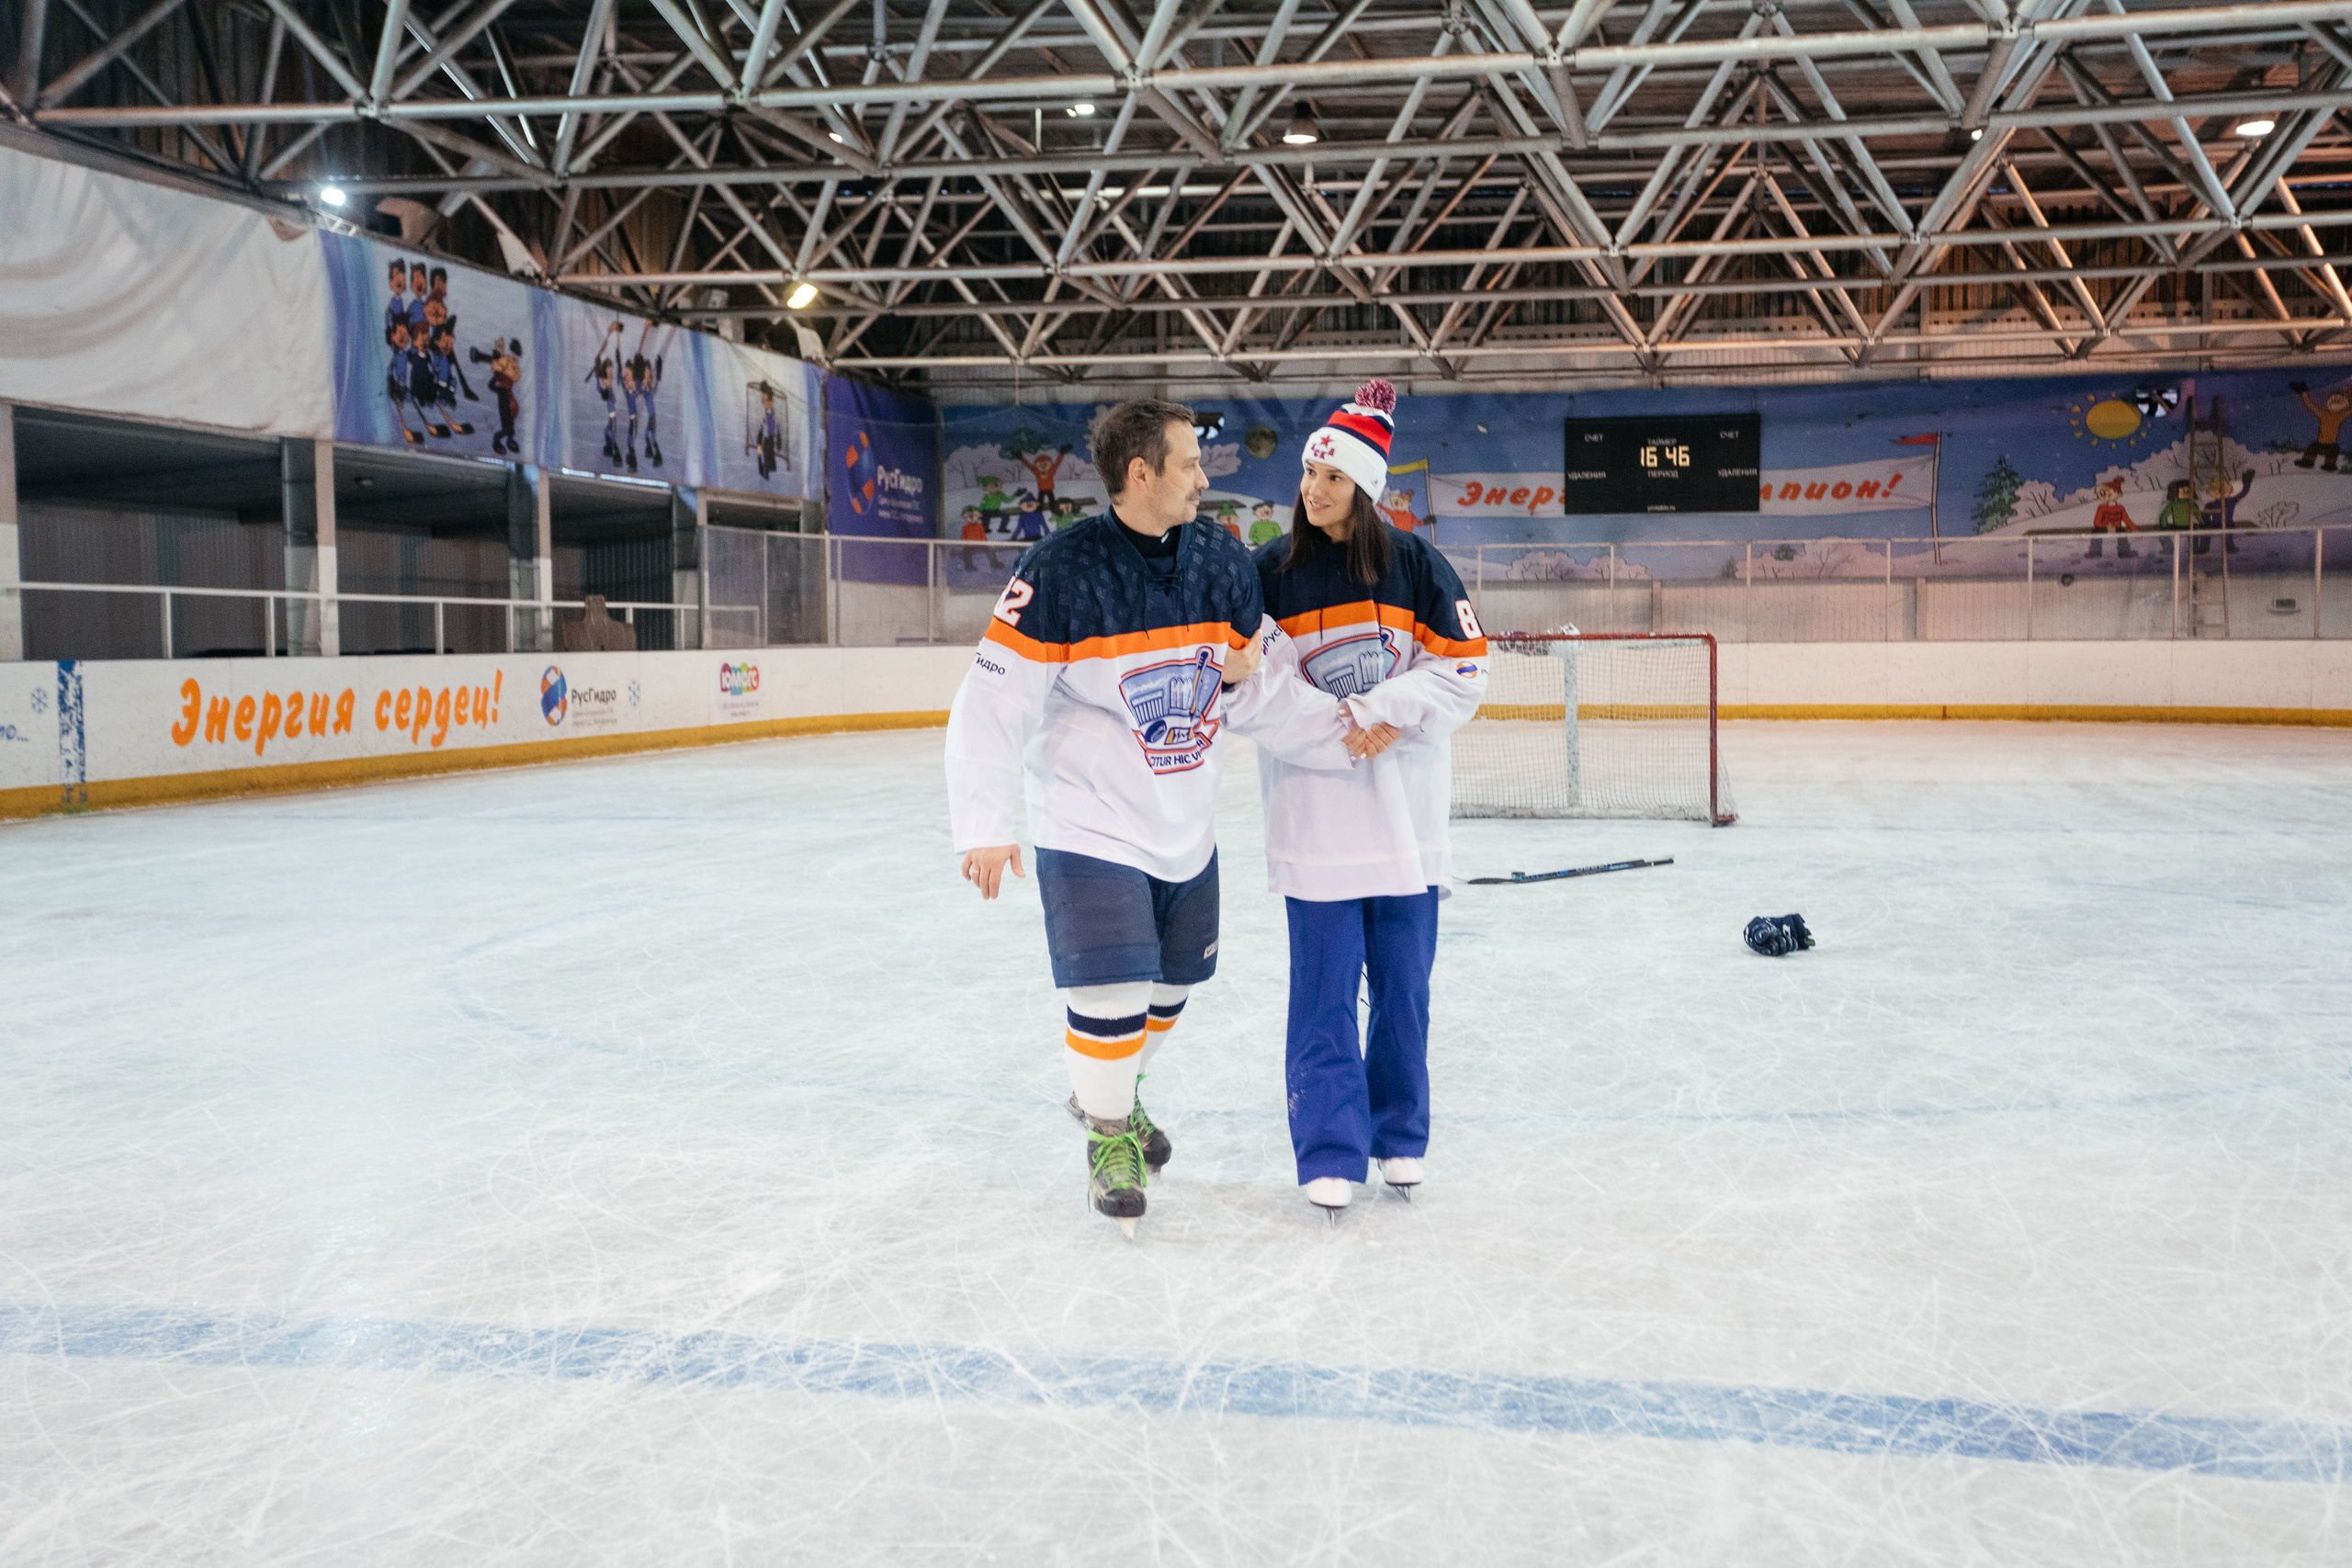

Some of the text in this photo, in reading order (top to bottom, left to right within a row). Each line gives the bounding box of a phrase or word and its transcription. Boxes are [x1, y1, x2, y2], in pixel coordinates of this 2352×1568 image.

[1640, 445, 1690, 468] 16 46
[1567, 470, 1607, 480] УДАЛЕНИЯ
[1647, 469, 1679, 479] ПЕРИОД
[1717, 468, 1758, 478] УДАЛЕНИЯ
[993, 575, 1035, 627] 2
[571, 687, 616, 706] РусГидро
[171, 668, 503, 757] Энергия сердец!
[1173, 754, 1192, 765] HIC
